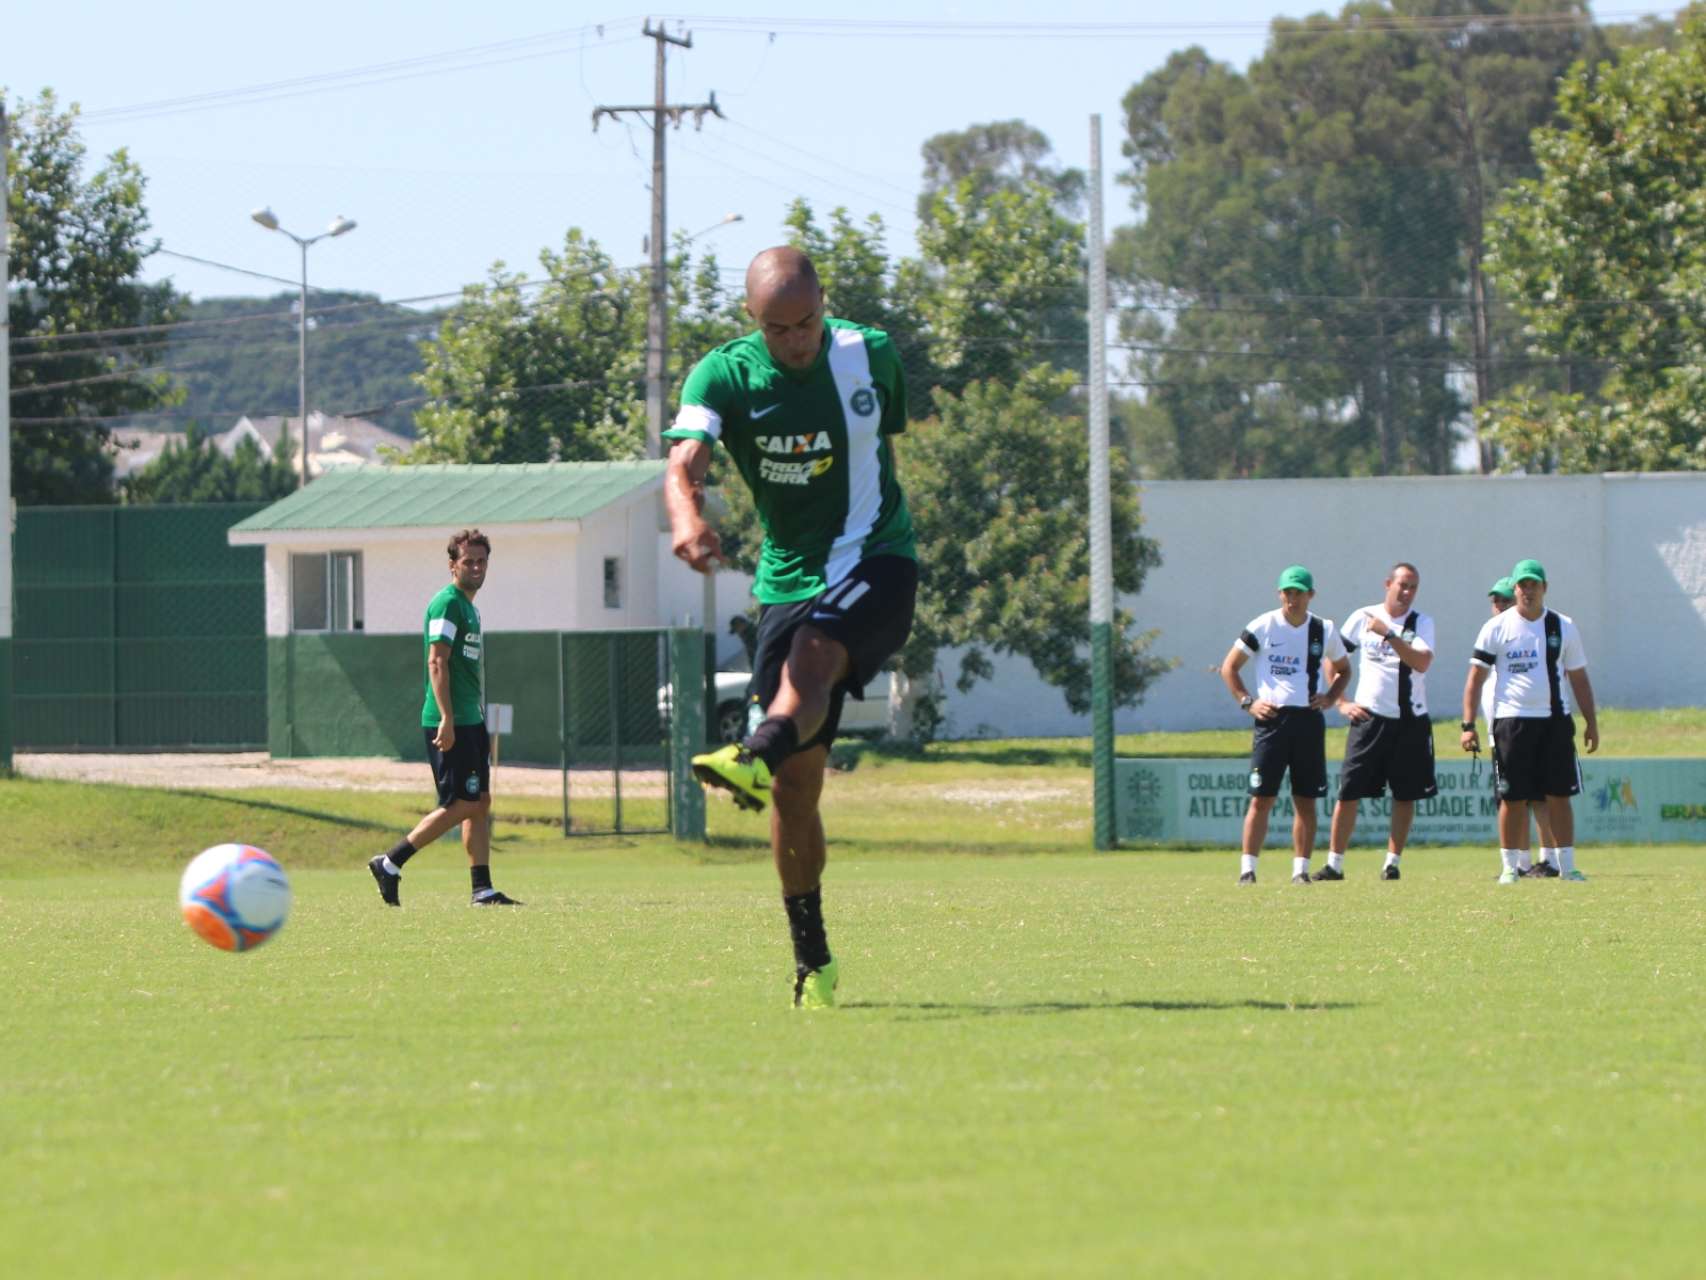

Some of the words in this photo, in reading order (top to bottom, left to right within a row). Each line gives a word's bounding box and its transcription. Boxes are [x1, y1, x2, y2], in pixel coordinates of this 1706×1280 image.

[755, 431, 832, 453] CAIXA
[1268, 654, 1300, 665] CAIXA
[1506, 650, 1537, 660] CAIXA
[1188, 773, 1249, 790] COLABO
[1370, 796, 1474, 817] SOEDADE
